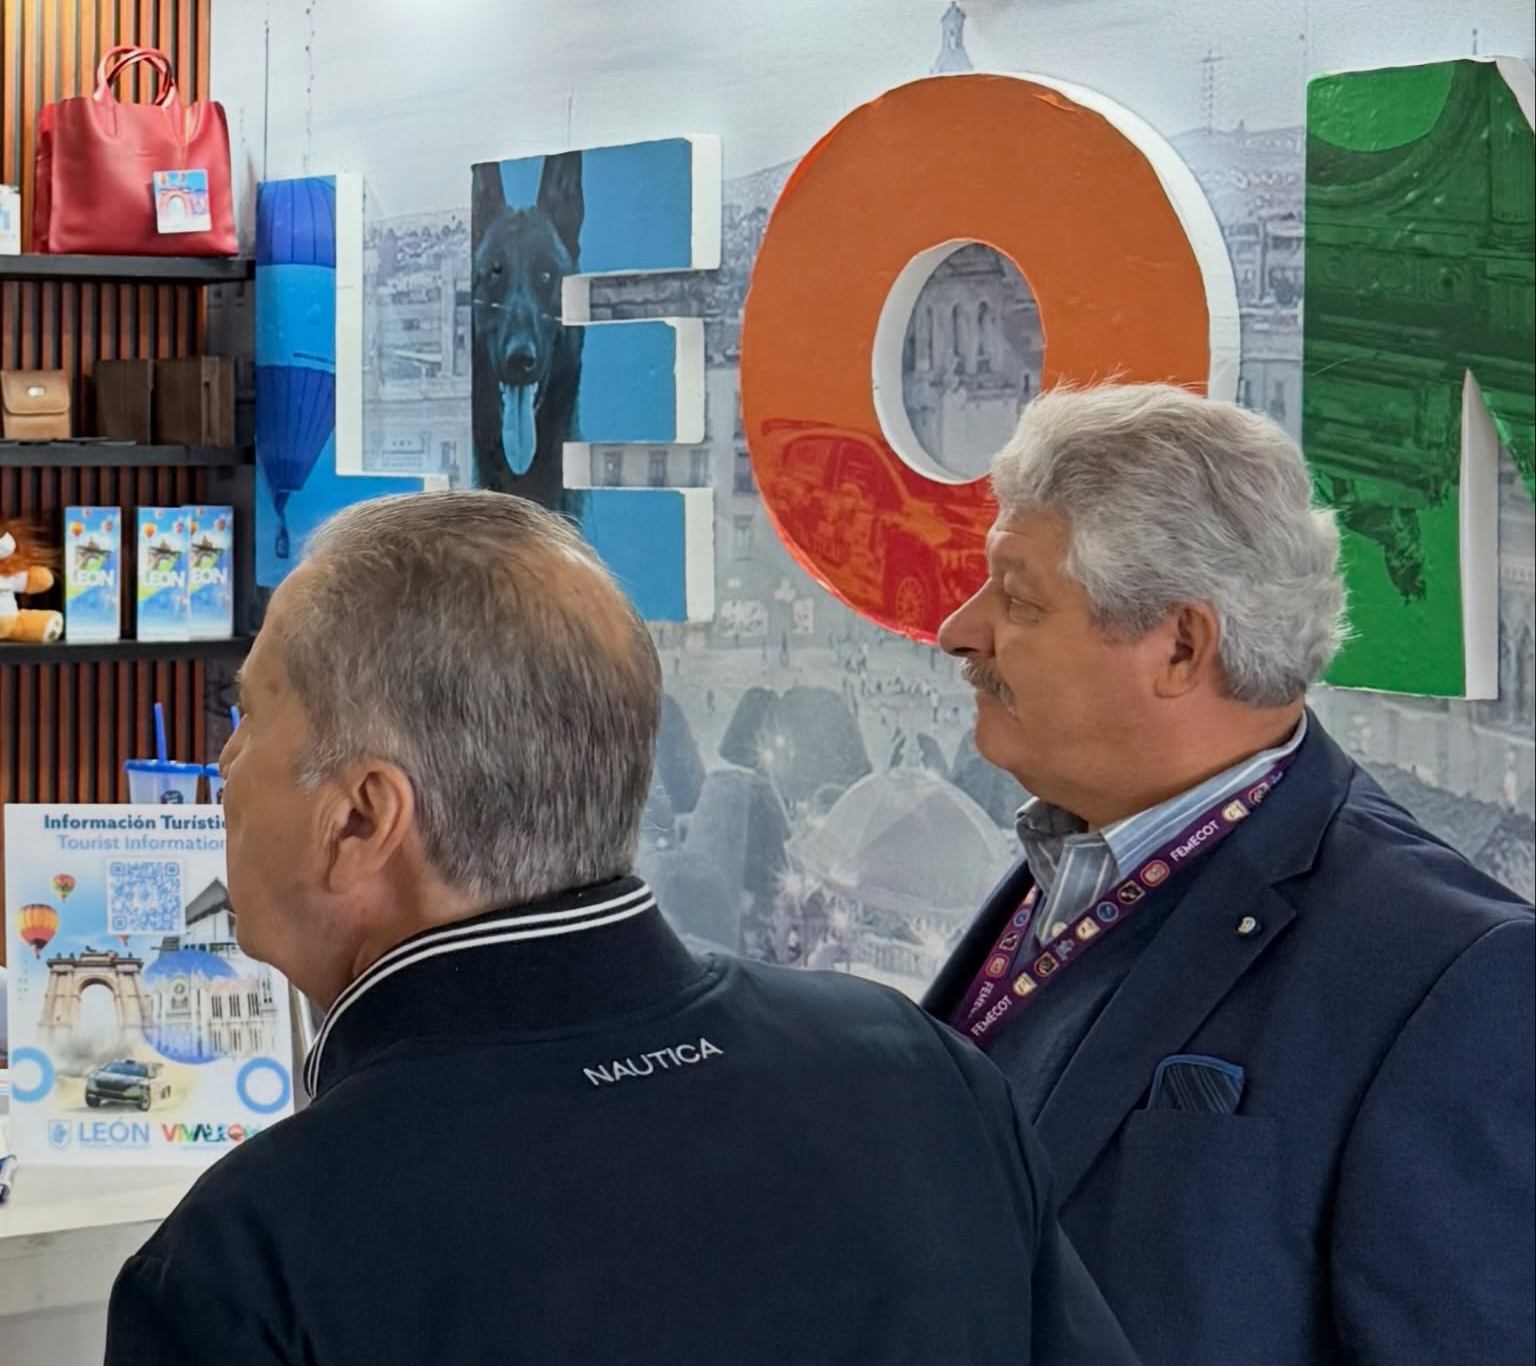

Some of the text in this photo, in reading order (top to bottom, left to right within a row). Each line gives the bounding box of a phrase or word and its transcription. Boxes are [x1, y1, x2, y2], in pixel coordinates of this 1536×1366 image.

[44, 813, 156, 831] Información
[57, 834, 120, 851] Tourist
[1170, 819, 1219, 862] FEMECOT
[970, 995, 1012, 1036] FEMECOT
[582, 1036, 725, 1087] NAUTICA
[78, 1117, 150, 1143] LEÓN
